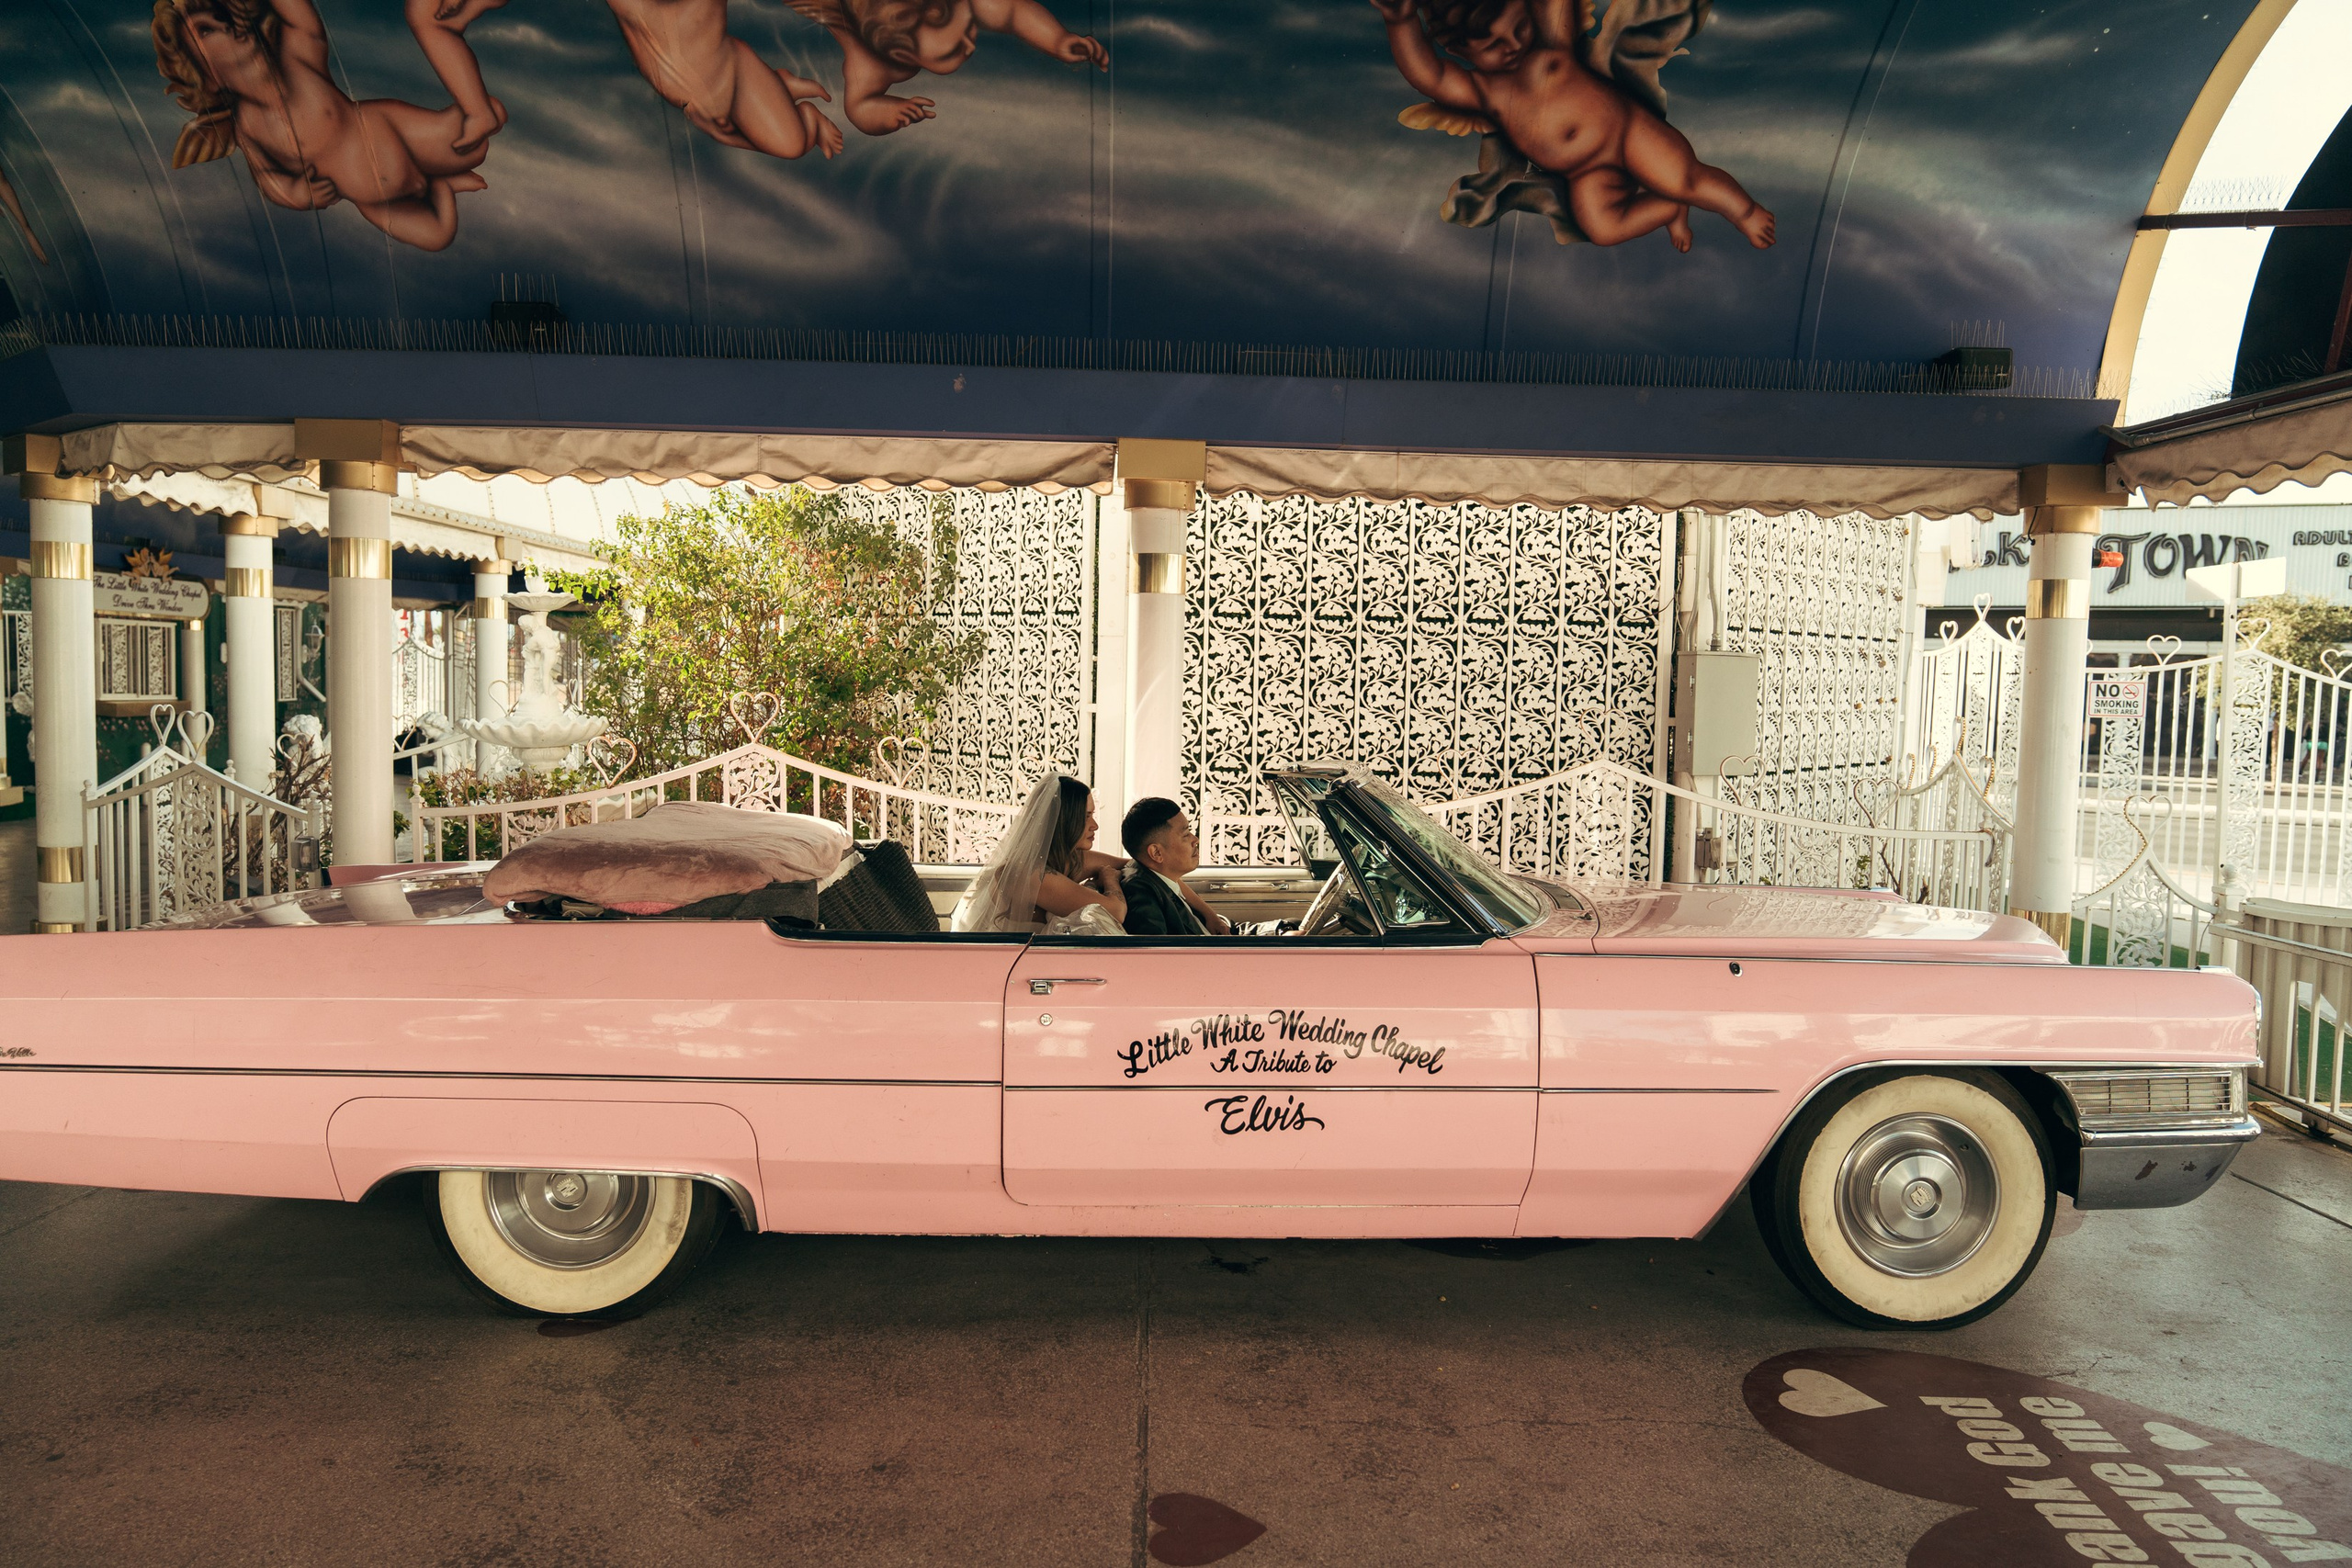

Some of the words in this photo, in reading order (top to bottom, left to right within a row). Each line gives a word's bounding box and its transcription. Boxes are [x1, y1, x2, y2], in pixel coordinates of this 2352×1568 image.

[107, 576, 127, 591] Little
[151, 581, 179, 600] Wedding
[180, 584, 203, 601] Chapel
[112, 593, 134, 607] Drive
[157, 598, 184, 612] Window
[2095, 700, 2139, 708] SMOKING
[2096, 684, 2120, 697] NO
[1117, 1027, 1193, 1078] Little
[1191, 1013, 1265, 1050] White
[1268, 1009, 1368, 1059] Wedding
[1371, 1024, 1446, 1075] Chapel
[1210, 1048, 1238, 1073] A
[1242, 1048, 1311, 1073] Tribute
[1315, 1050, 1338, 1074] to
[1204, 1094, 1326, 1135] Elvis
[1918, 1396, 2051, 1467] God
[2019, 1396, 2131, 1453] me
[2004, 1476, 2161, 1568] ank
[2090, 1462, 2273, 1568] gave
[2165, 1463, 2352, 1562] you!
